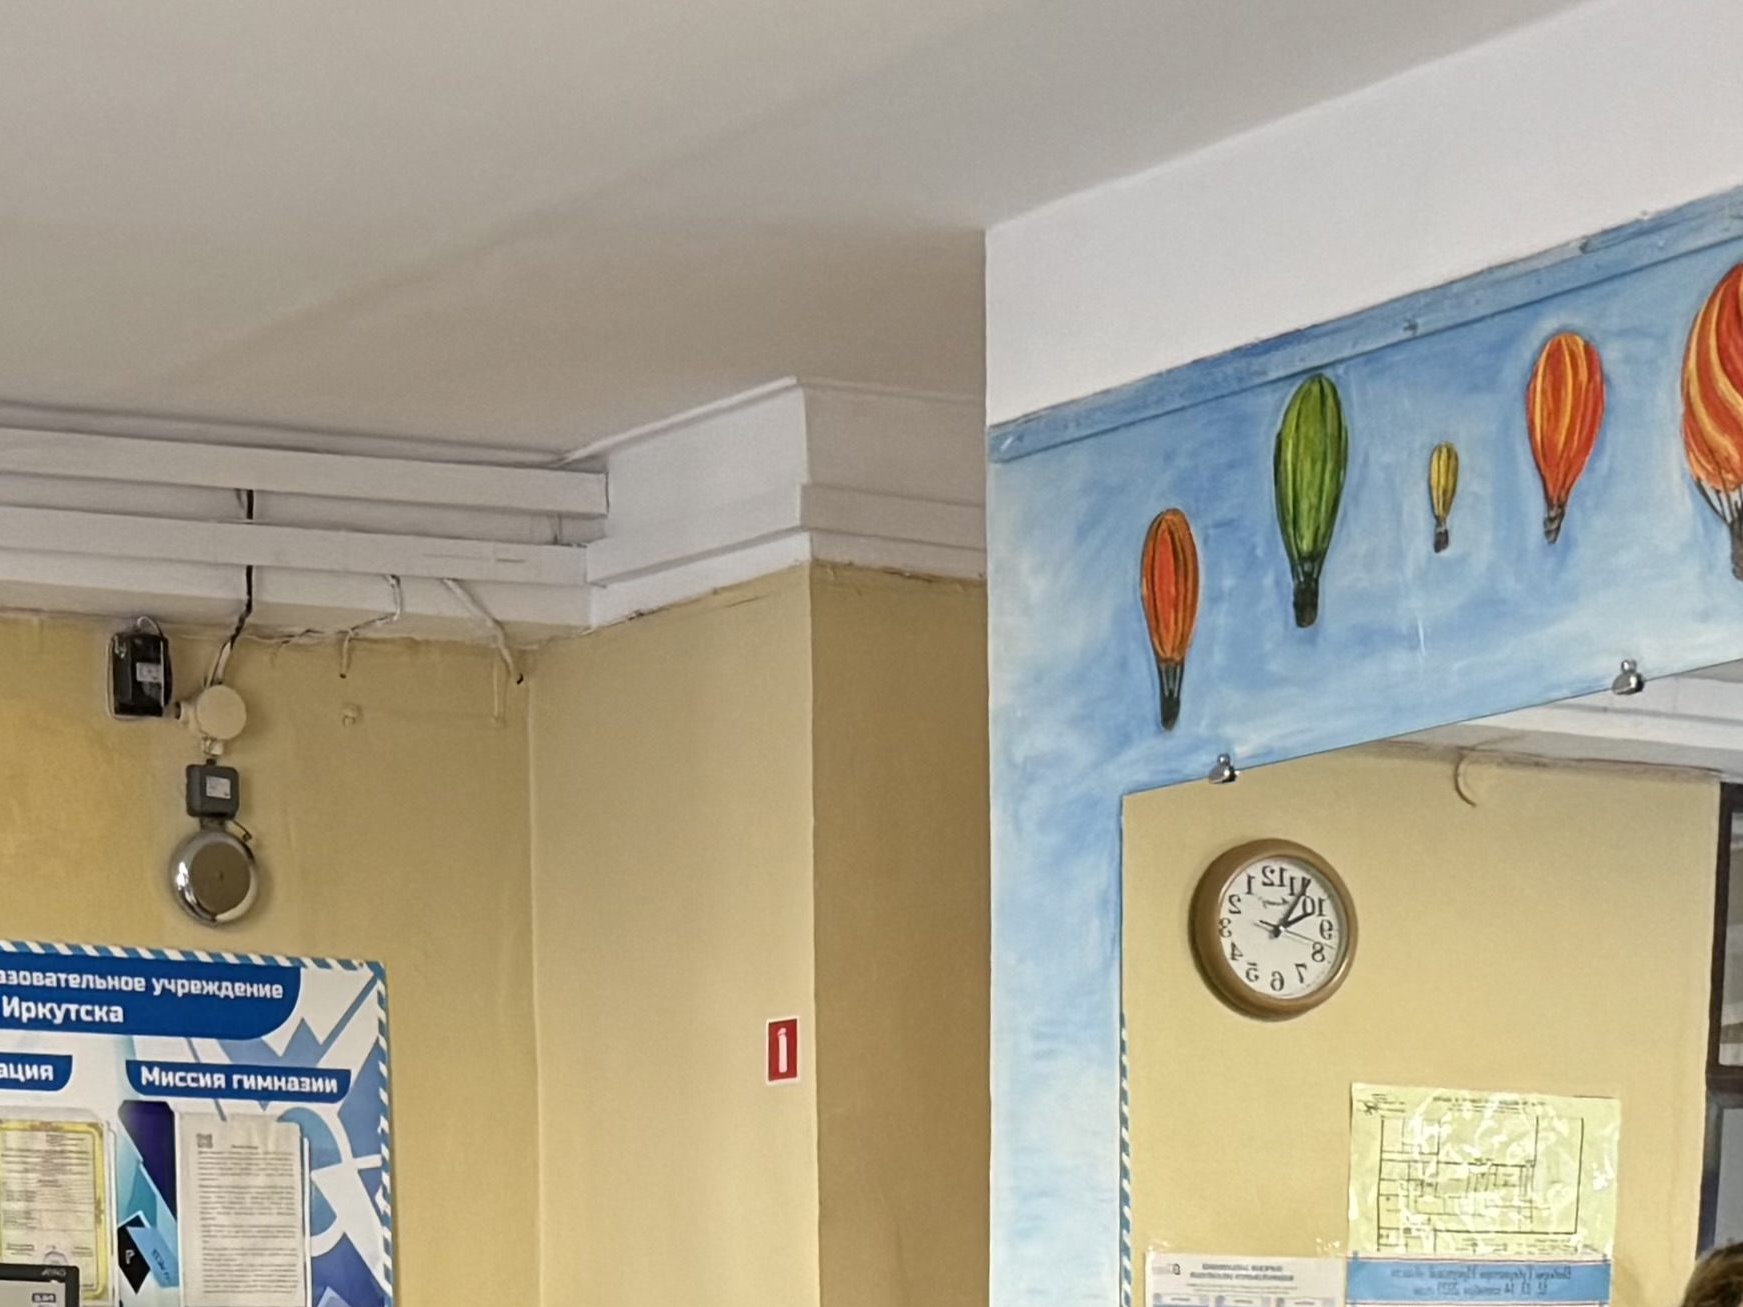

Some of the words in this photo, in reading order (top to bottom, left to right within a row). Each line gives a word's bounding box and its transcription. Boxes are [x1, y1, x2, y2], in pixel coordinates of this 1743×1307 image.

[152, 976, 284, 999] учреждение
[2, 996, 124, 1024] Иркутска
[140, 1065, 227, 1089] Миссия
[232, 1071, 338, 1093] гимназии
